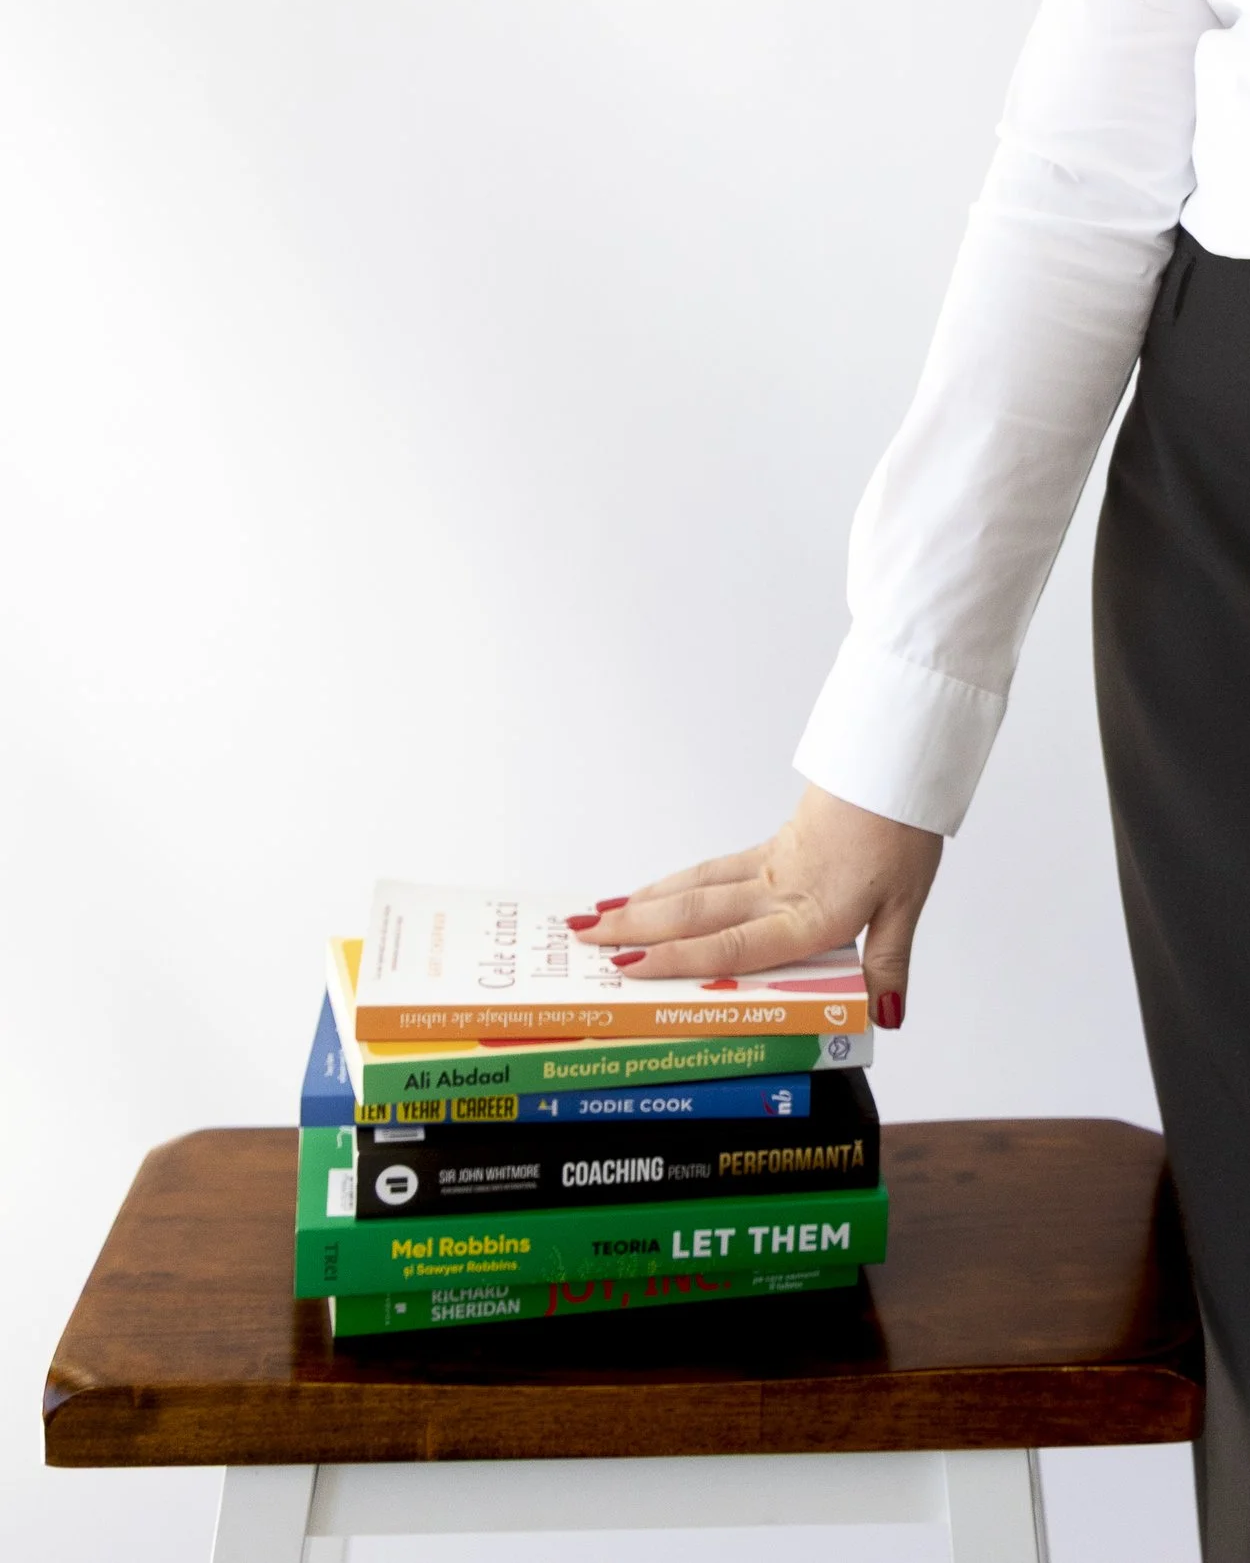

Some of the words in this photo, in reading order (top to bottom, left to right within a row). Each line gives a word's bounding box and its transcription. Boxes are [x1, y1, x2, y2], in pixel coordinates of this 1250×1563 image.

[485, 901, 518, 946] cinci
[478, 952, 516, 989] Cele
[399, 1010, 448, 1029] iubirii
[450, 1010, 473, 1028] ale
[476, 1009, 533, 1029] limbaje
[538, 1010, 575, 1028] cinci
[578, 1009, 614, 1026] Cele
[655, 1007, 740, 1024] CHAPMAN
[742, 1006, 787, 1023] GARY
[403, 1070, 431, 1091] Ali
[436, 1063, 510, 1088] Abdaal
[543, 1055, 620, 1080] Bucuria
[360, 1101, 387, 1121] TEN
[402, 1098, 440, 1120] YEAR
[456, 1095, 515, 1119] CAREER
[579, 1098, 635, 1115] JODIE
[639, 1097, 694, 1113] COOK
[562, 1155, 665, 1187] COACHING
[667, 1163, 712, 1181] PENTRU
[718, 1139, 864, 1177] PERFORMANȚĂ
[438, 1169, 457, 1185] SIR
[458, 1167, 484, 1184] JOHN
[485, 1164, 541, 1182] WHITMORE
[391, 1237, 434, 1259] Mel
[439, 1234, 532, 1257] Robbins
[592, 1238, 661, 1256] TEORIA
[672, 1228, 736, 1259] LET
[748, 1222, 851, 1254] THEM
[416, 1262, 464, 1277] Sawyer
[466, 1260, 518, 1274] Robbins
[431, 1298, 521, 1322] SHERIDAN
